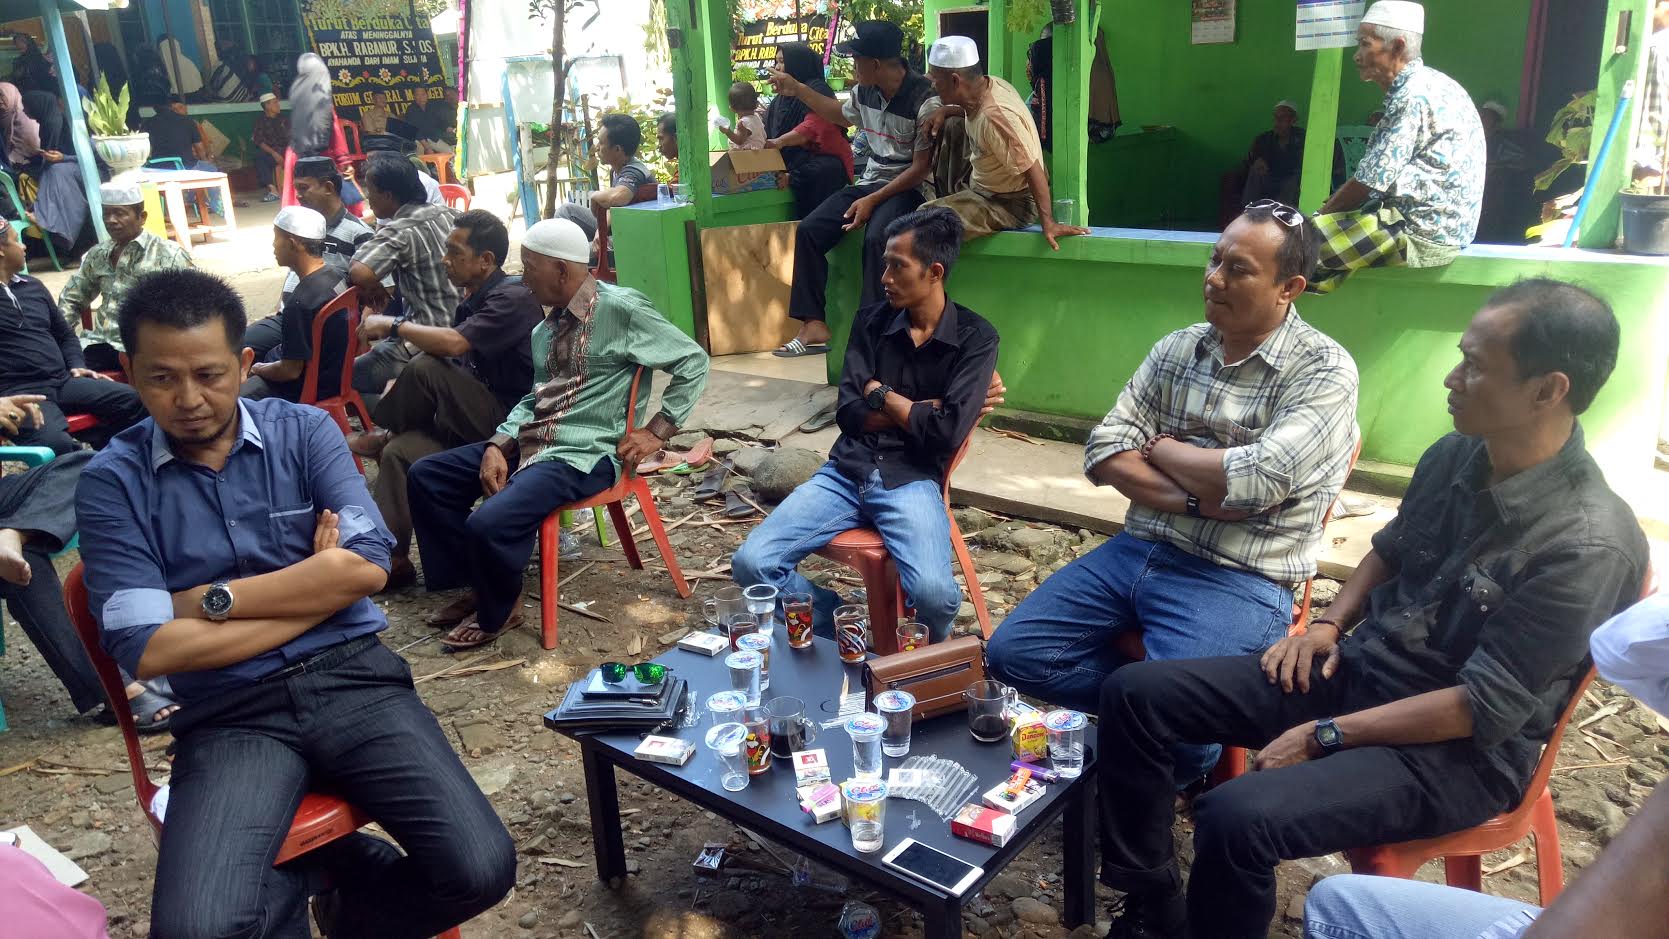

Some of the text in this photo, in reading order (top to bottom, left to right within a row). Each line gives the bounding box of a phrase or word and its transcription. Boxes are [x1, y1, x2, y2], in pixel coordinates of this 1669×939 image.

[340, 30, 413, 40] ATAS MENINGGALNYA
[766, 20, 808, 37] Berdua
[333, 93, 361, 106] FORUM
